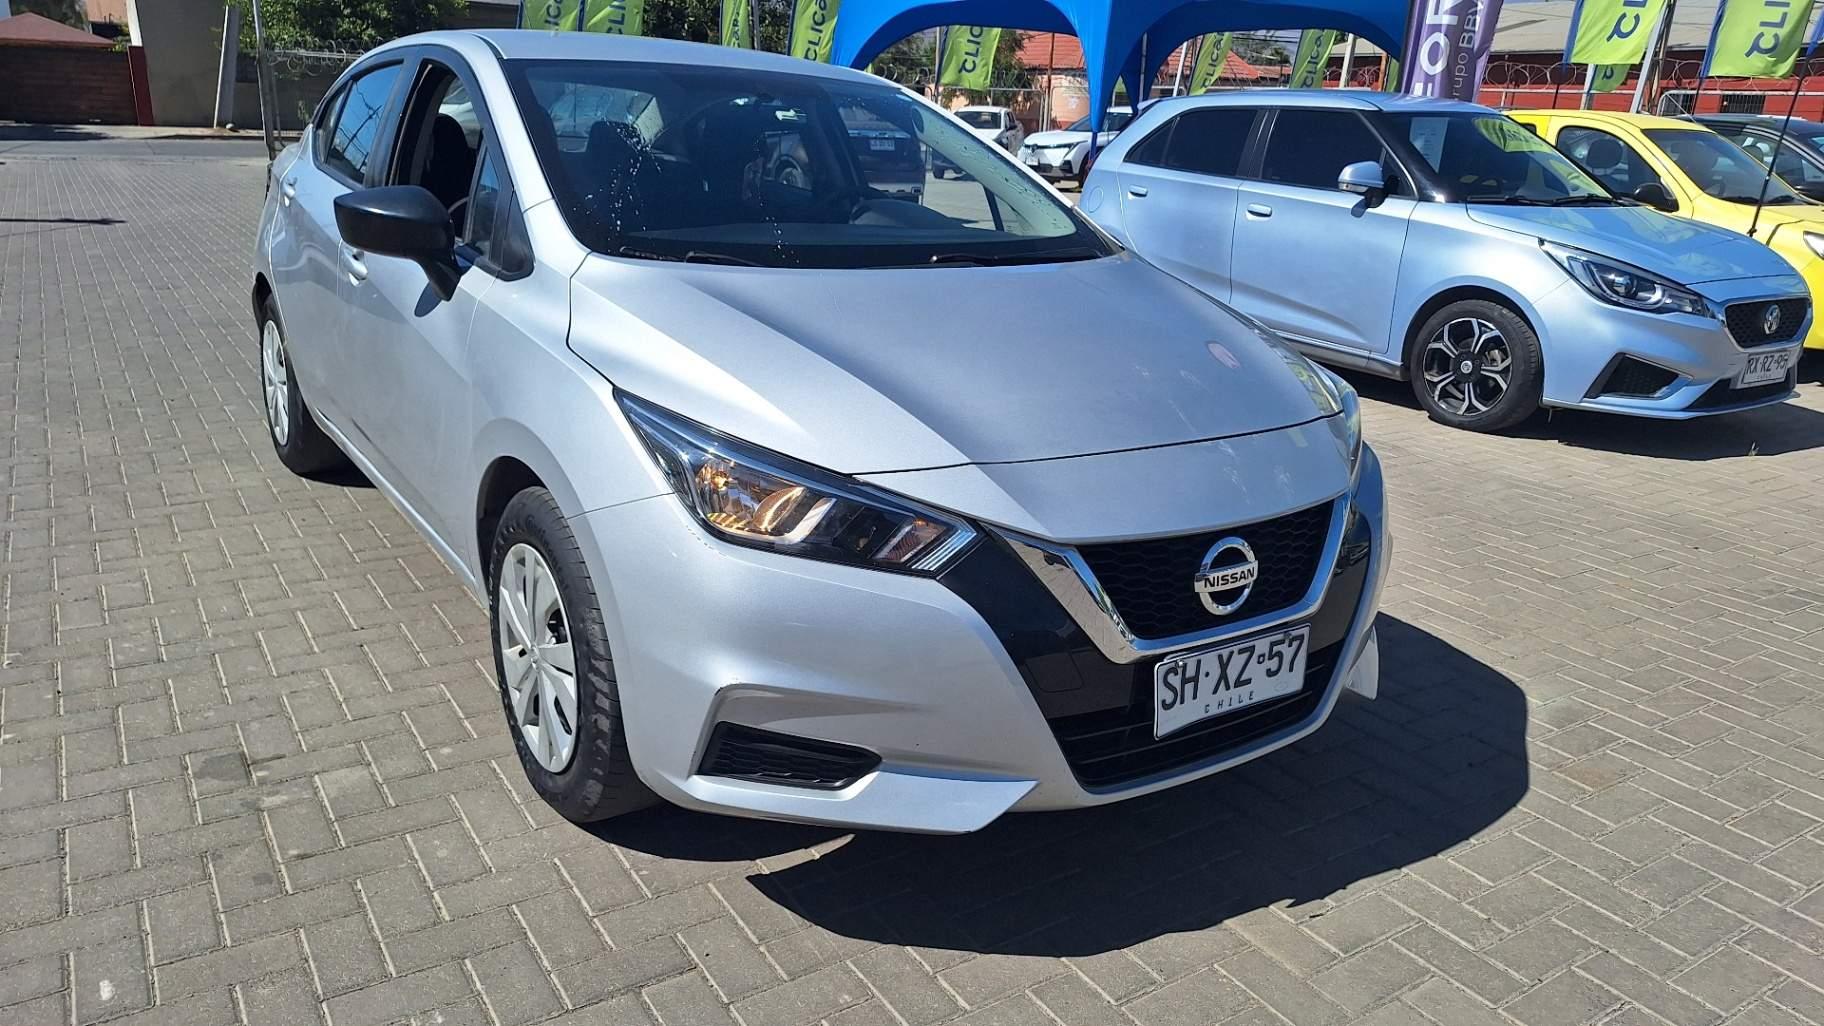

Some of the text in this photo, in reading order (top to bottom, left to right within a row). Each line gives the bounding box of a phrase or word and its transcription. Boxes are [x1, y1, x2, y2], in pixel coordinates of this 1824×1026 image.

[1453, 52, 1469, 100] rupo
[1204, 566, 1255, 588] NISSAN
[1204, 691, 1254, 714] CHILE
